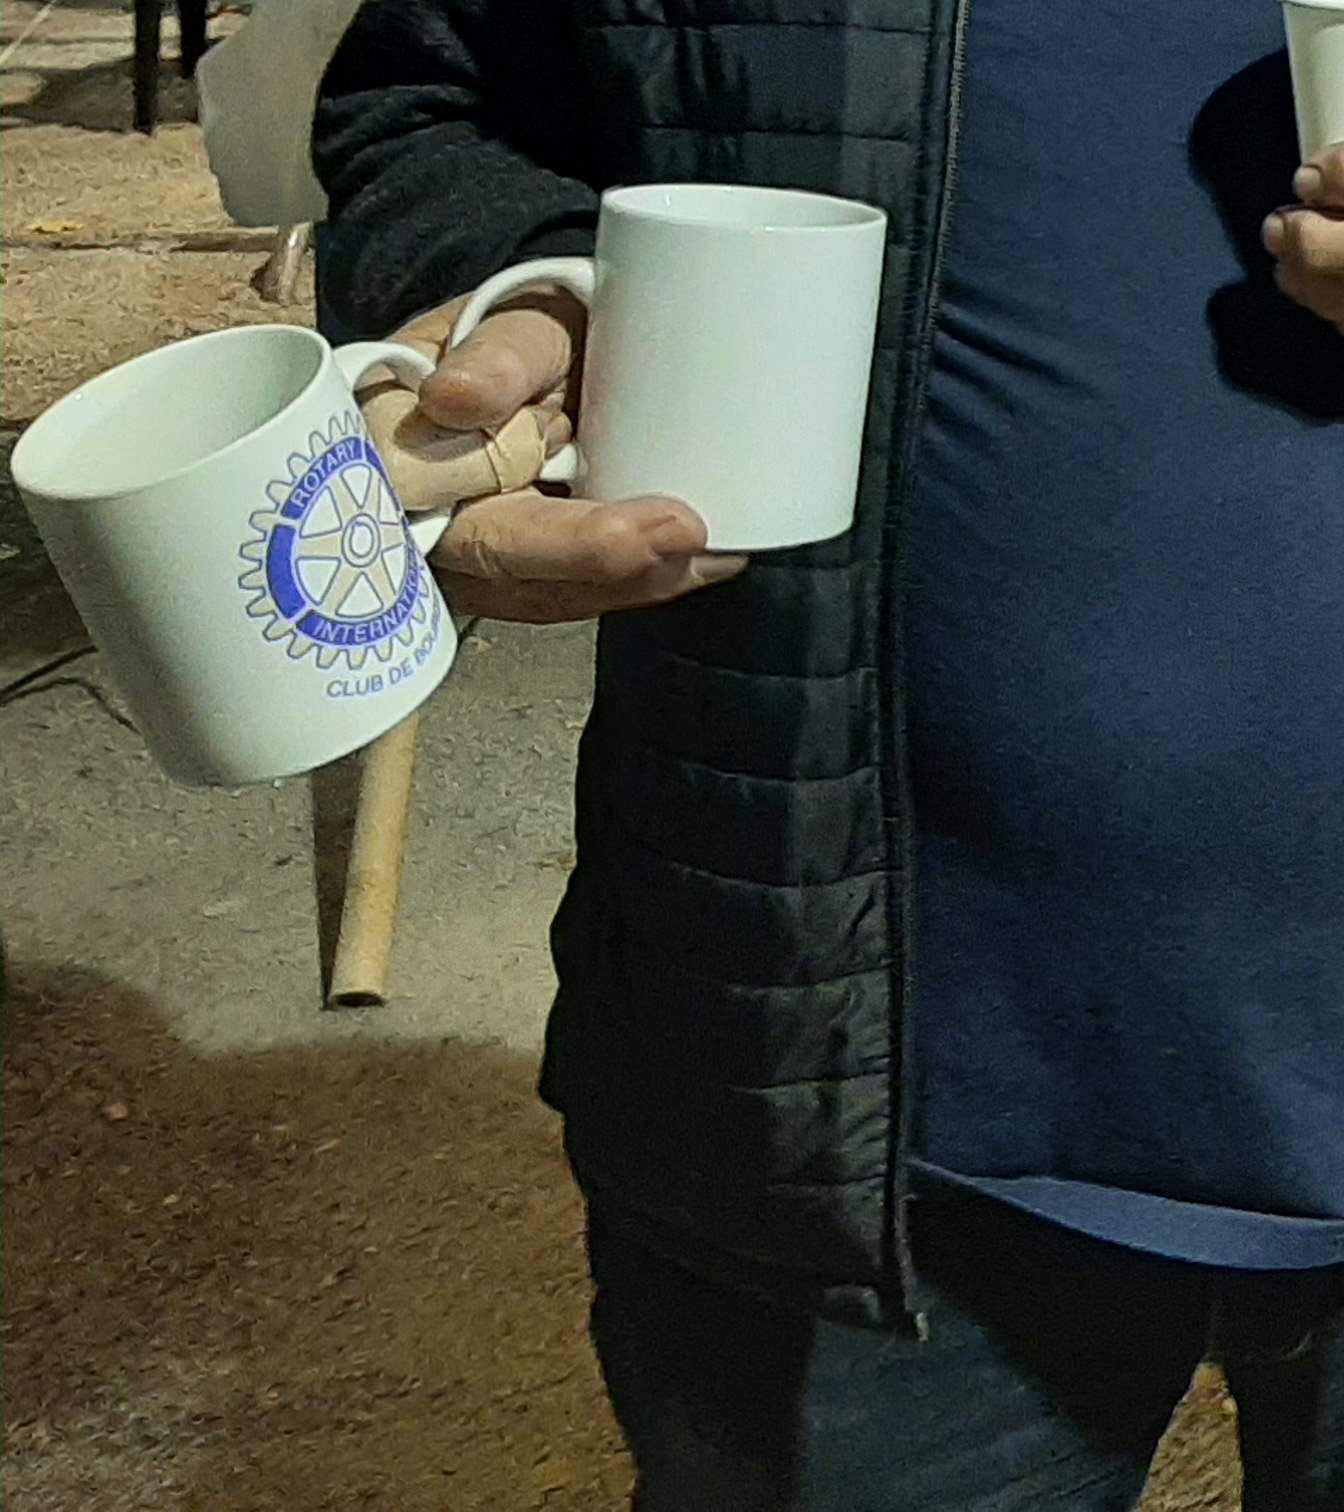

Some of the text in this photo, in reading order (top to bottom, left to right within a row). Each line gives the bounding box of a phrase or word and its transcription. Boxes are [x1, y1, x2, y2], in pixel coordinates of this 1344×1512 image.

[290, 439, 355, 508] ROTARY
[311, 548, 420, 643] INTERNATIO
[326, 674, 384, 698] CLUB
[389, 657, 414, 685] DE
